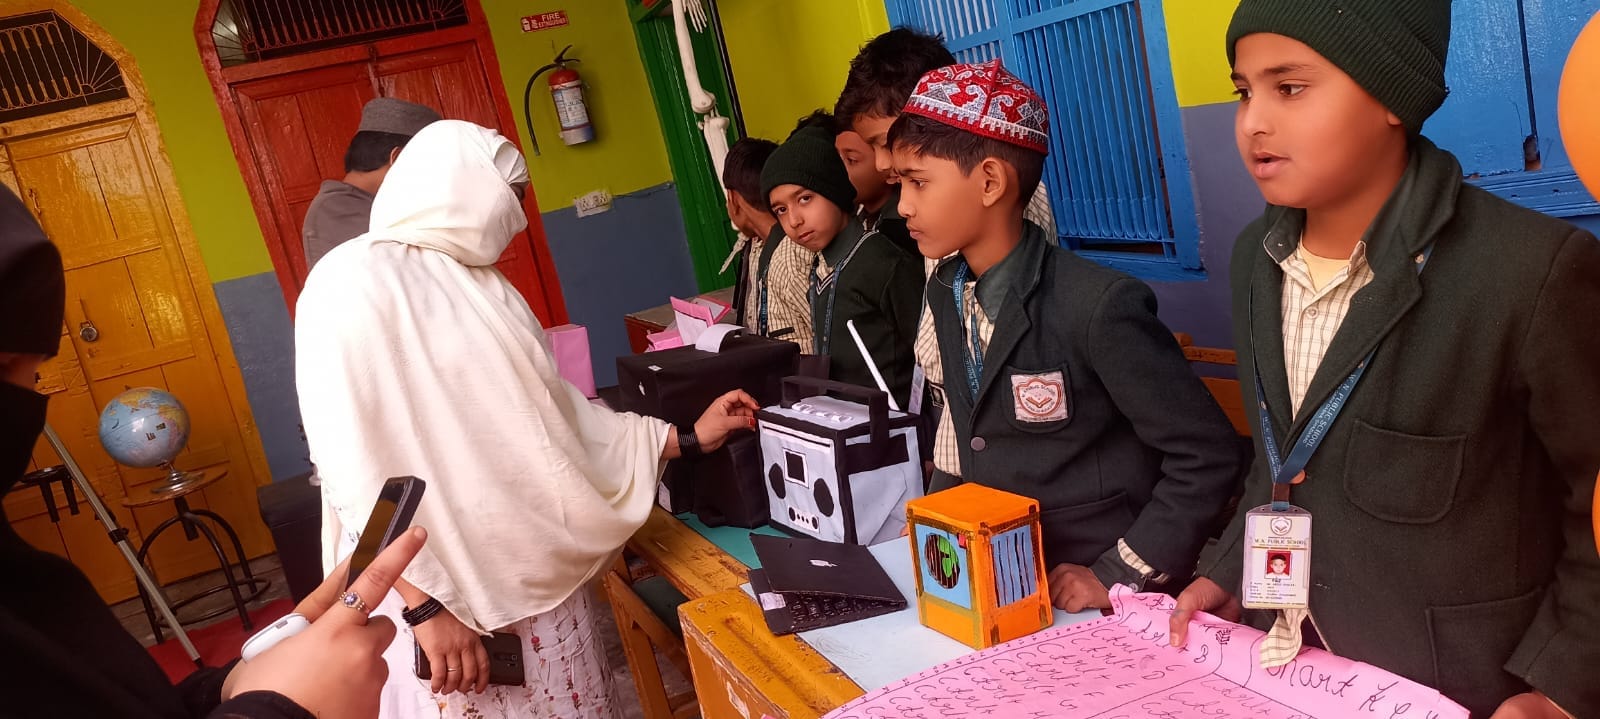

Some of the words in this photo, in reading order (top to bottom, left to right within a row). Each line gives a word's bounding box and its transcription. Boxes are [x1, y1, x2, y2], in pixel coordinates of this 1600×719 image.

[541, 12, 561, 21] FIRE
[1324, 393, 1344, 421] PUBLIC
[1306, 420, 1327, 448] SCHOOL
[1193, 643, 1209, 664] B
[1142, 670, 1166, 681] D
